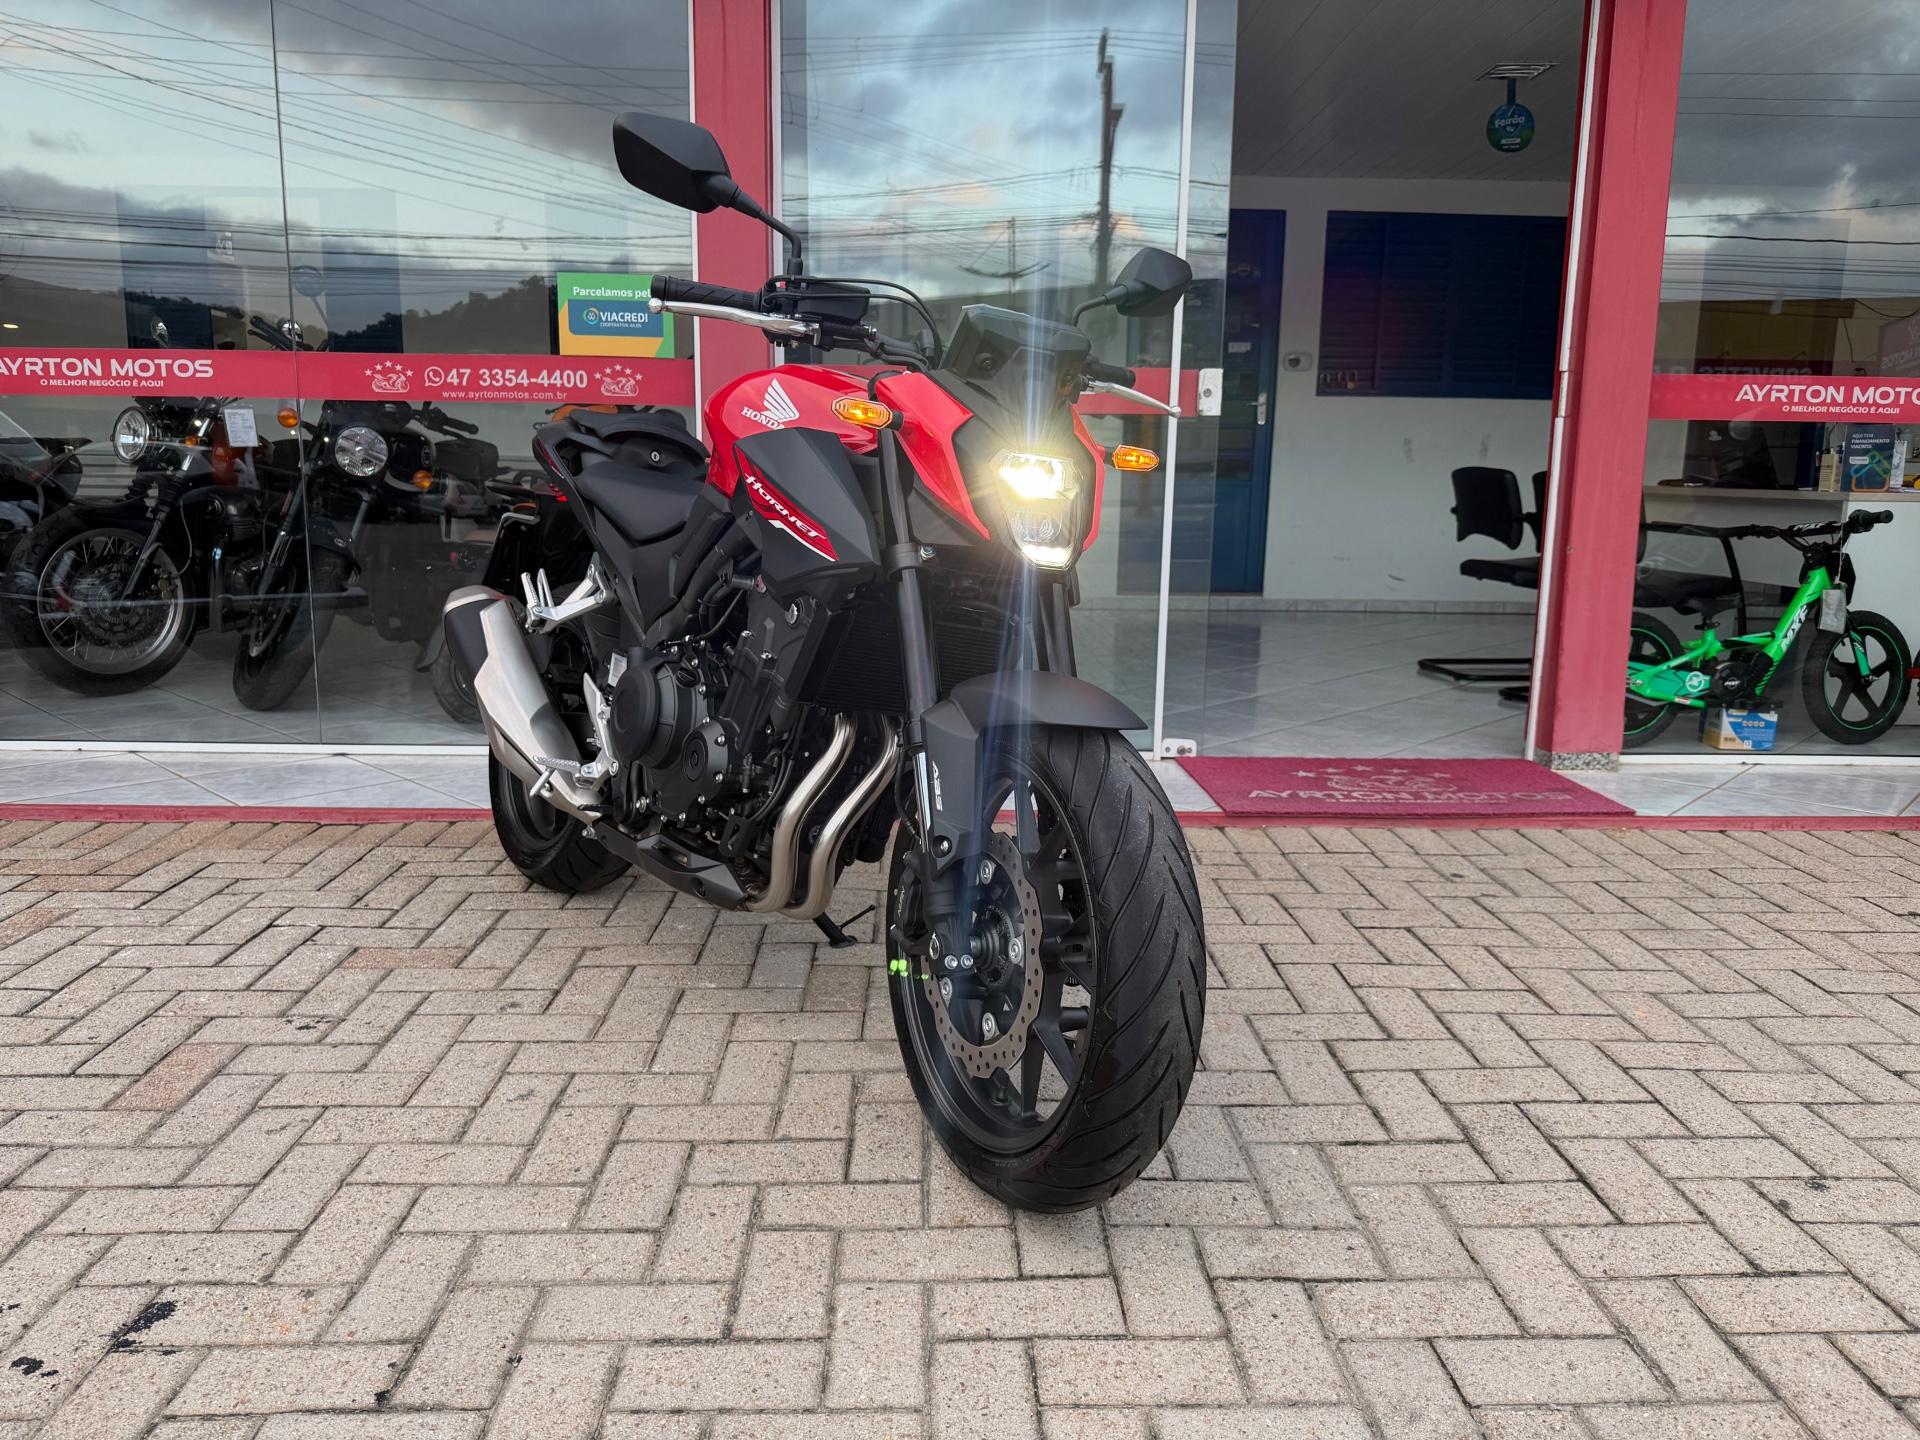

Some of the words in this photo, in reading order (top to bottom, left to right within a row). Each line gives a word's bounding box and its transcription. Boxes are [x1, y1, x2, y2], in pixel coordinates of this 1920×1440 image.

[573, 286, 633, 298] Parcelamos
[635, 288, 652, 299] pel
[600, 312, 648, 323] VIACREDI
[111, 358, 214, 378] MOTOS
[40, 378, 48, 387] O
[49, 378, 88, 387] MELHOR
[89, 377, 131, 388] NEGÓCIO
[133, 377, 139, 388] É
[140, 379, 164, 388] AQUI
[446, 368, 472, 387] 47
[479, 369, 588, 388] 3354-4400
[442, 389, 567, 401] www.ayrtonmotos.com.br
[1735, 384, 1844, 404] AYRTON
[1791, 405, 1828, 413] MELHOR
[1828, 404, 1868, 414] NEGÓCIO
[1870, 405, 1876, 414] É
[1877, 407, 1900, 415] AQUI
[744, 472, 827, 540] HORNET
[932, 760, 943, 812] ABS
[1248, 789, 1413, 800] AYRTON
[1422, 791, 1573, 801] MOTOS
